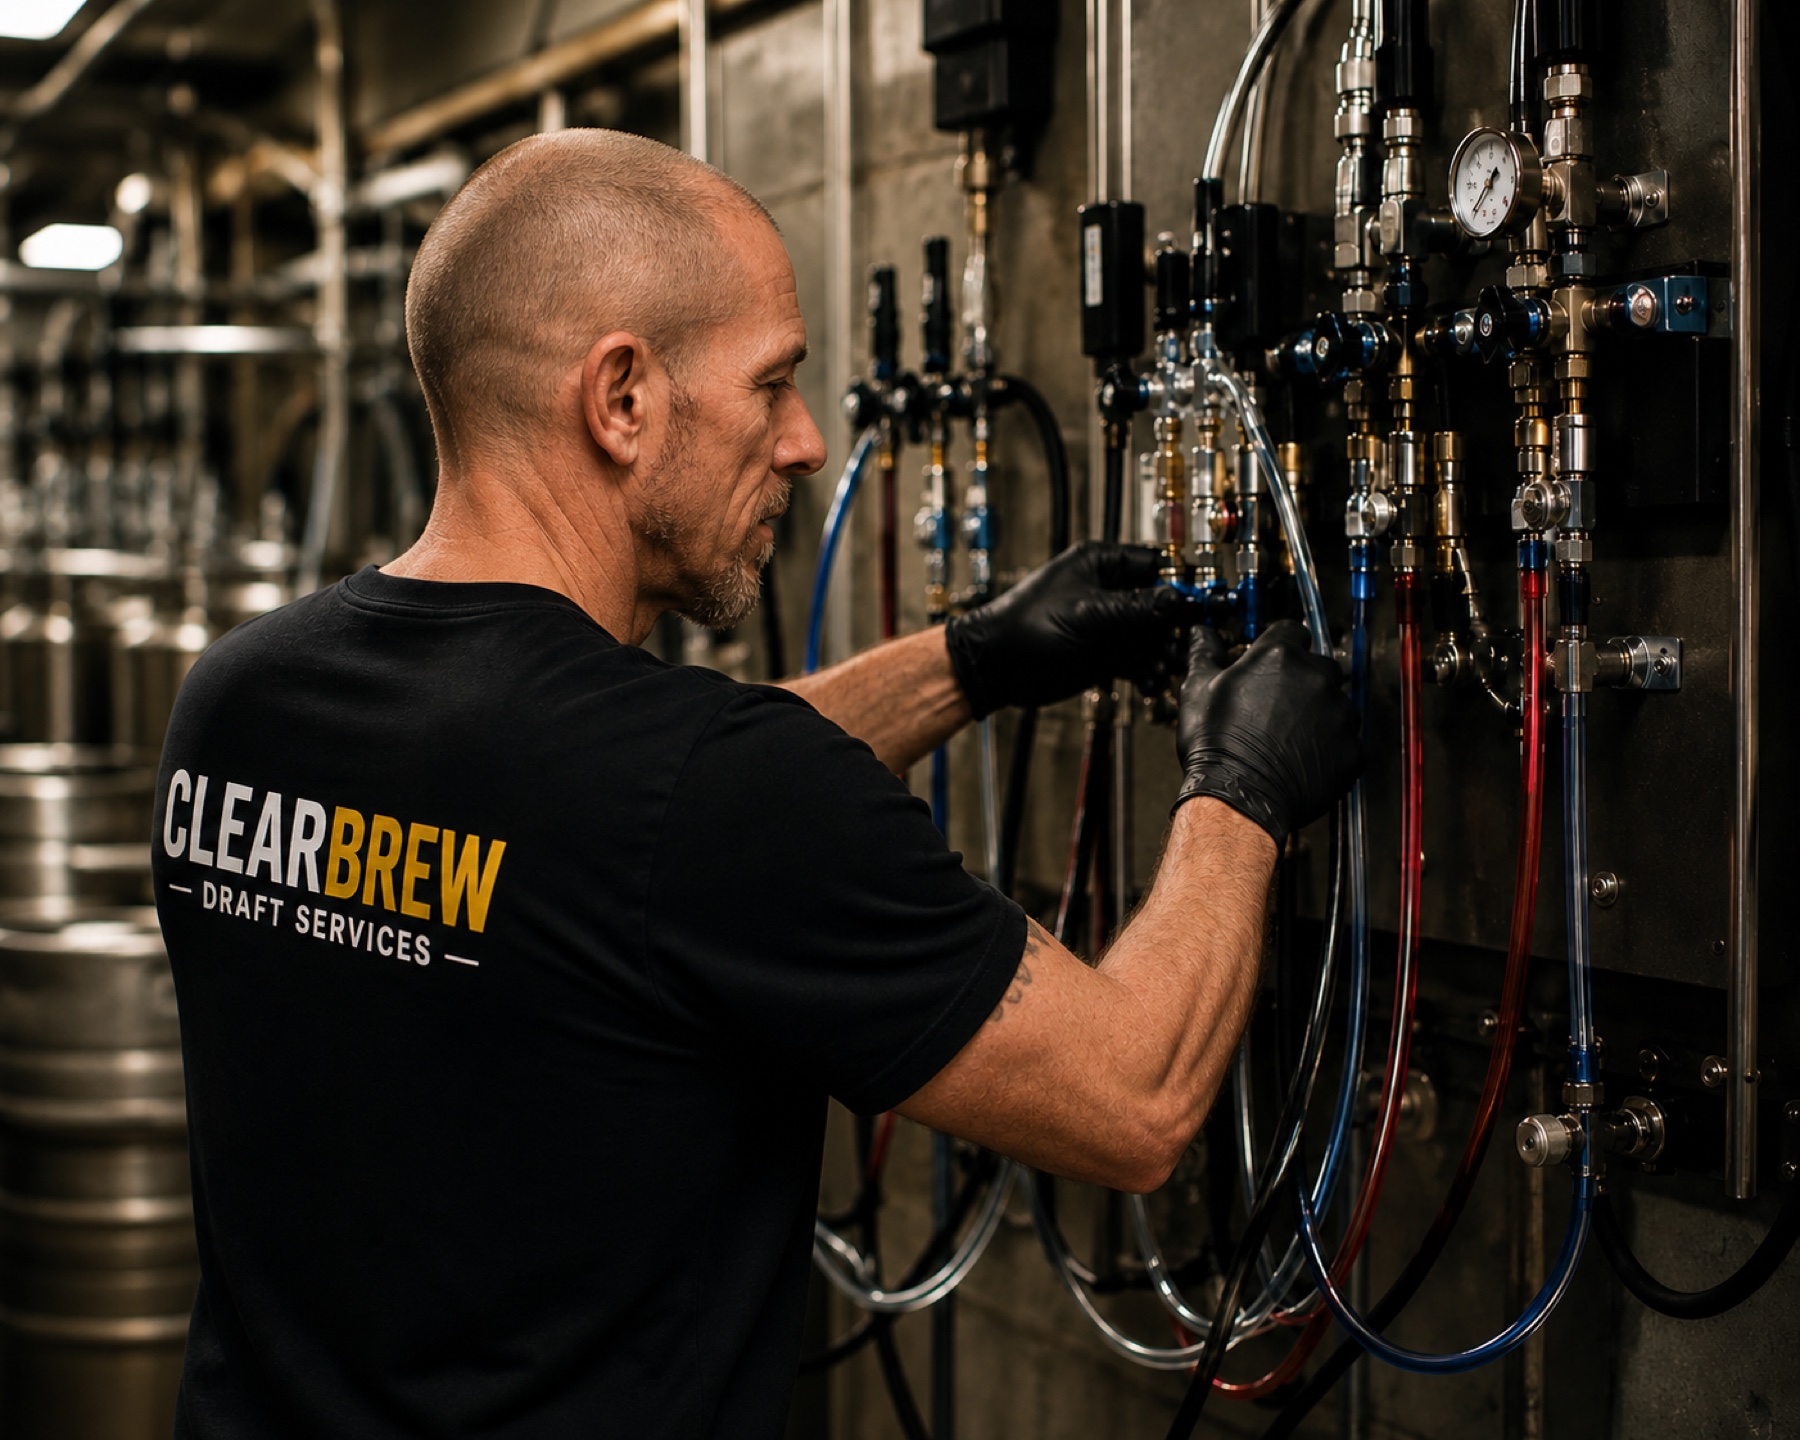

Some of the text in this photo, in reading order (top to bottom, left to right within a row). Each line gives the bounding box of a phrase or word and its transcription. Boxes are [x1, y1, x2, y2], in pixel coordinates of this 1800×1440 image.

[163, 768, 507, 934] CLEARBREW
[202, 880, 432, 967] DRAFT SERVICES
